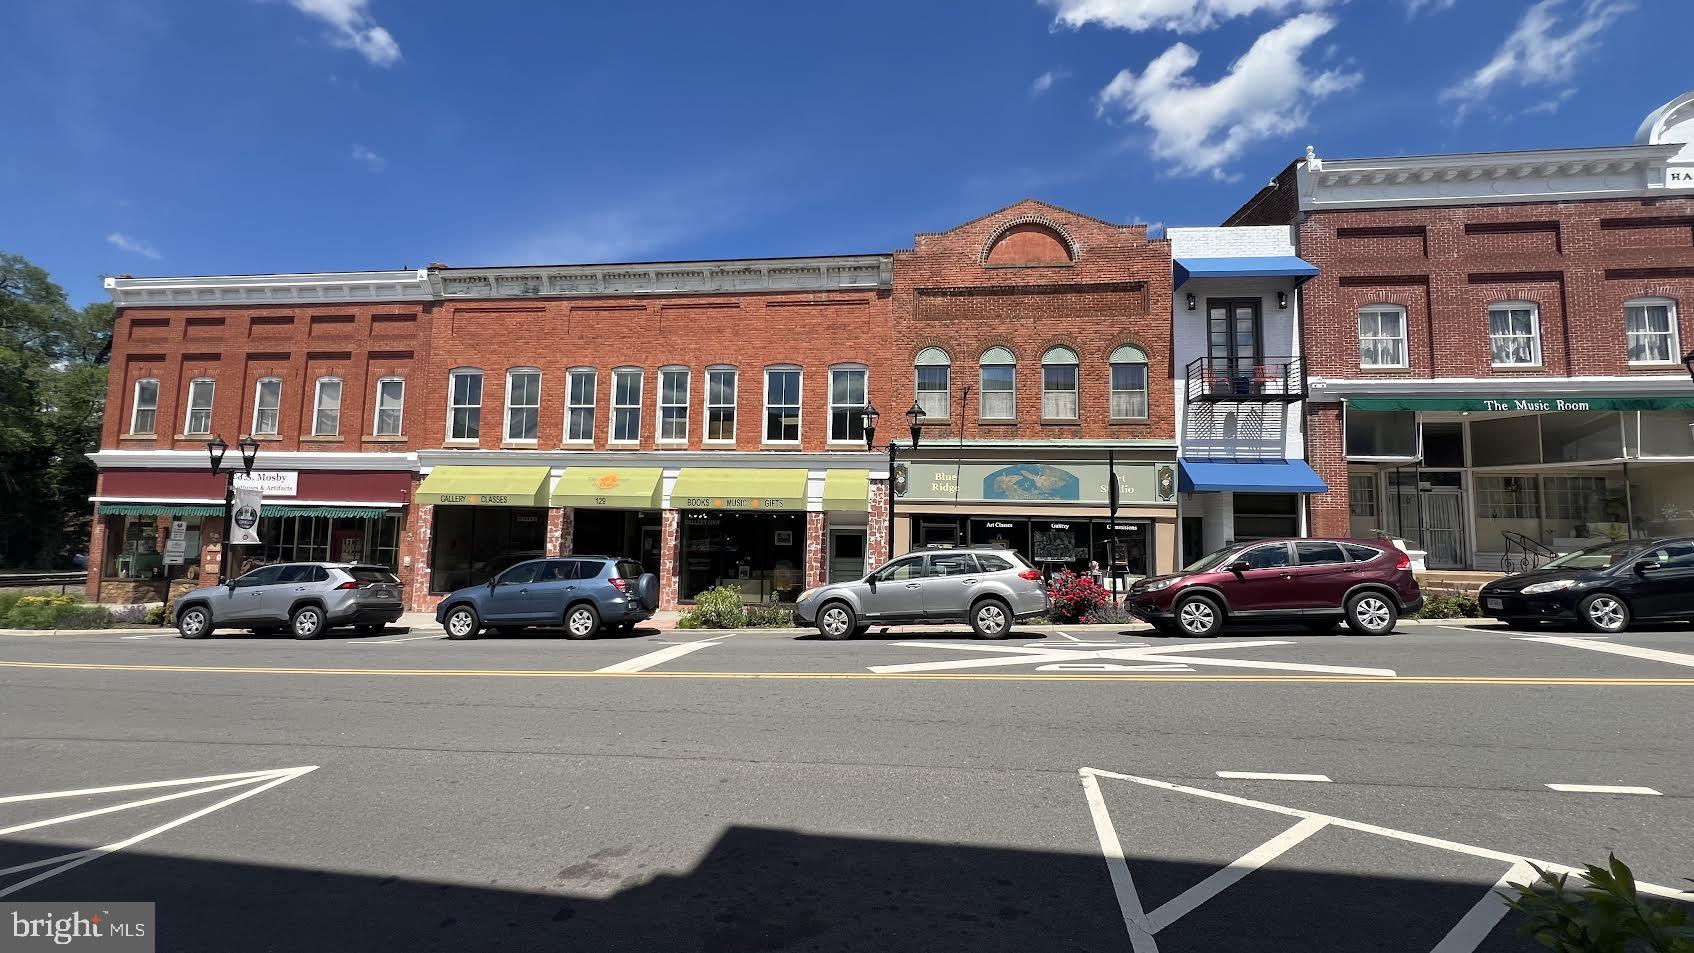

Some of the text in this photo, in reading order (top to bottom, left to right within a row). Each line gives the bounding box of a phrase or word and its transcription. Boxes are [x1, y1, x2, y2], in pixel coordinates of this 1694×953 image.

[1484, 399, 1589, 411] The Music Room
[257, 473, 287, 484] Mosby
[935, 472, 957, 481] Blue
[932, 483, 960, 494] Ridge
[440, 494, 508, 504] GALLERY CLASSES
[595, 497, 606, 505] 129
[687, 498, 784, 508] BOOKS MUSIC GIFTS
[1051, 523, 1070, 531] Gallery
